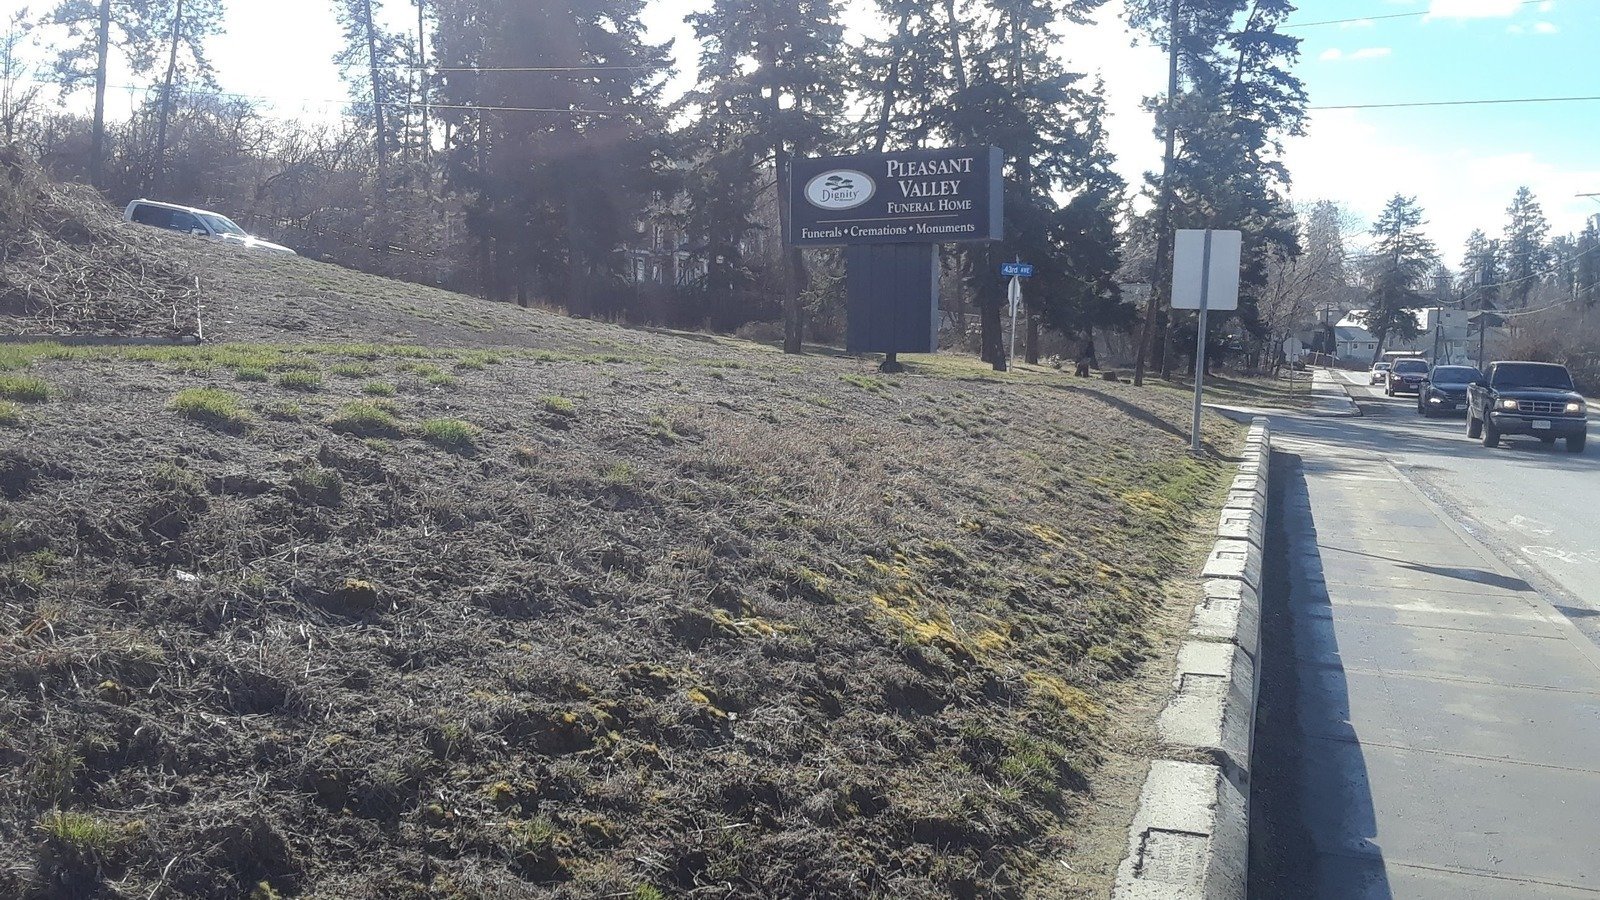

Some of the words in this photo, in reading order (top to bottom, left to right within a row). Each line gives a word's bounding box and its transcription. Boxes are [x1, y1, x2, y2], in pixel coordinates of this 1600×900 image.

[886, 158, 973, 178] PLEASANT
[820, 190, 859, 203] Dignity
[898, 180, 961, 198] VALLEY
[887, 201, 935, 214] FUNERAL
[938, 199, 972, 211] HOME
[802, 226, 842, 239] Funerals
[850, 225, 907, 237] Cremations
[916, 223, 975, 234] Monuments
[1004, 265, 1018, 273] 43rd
